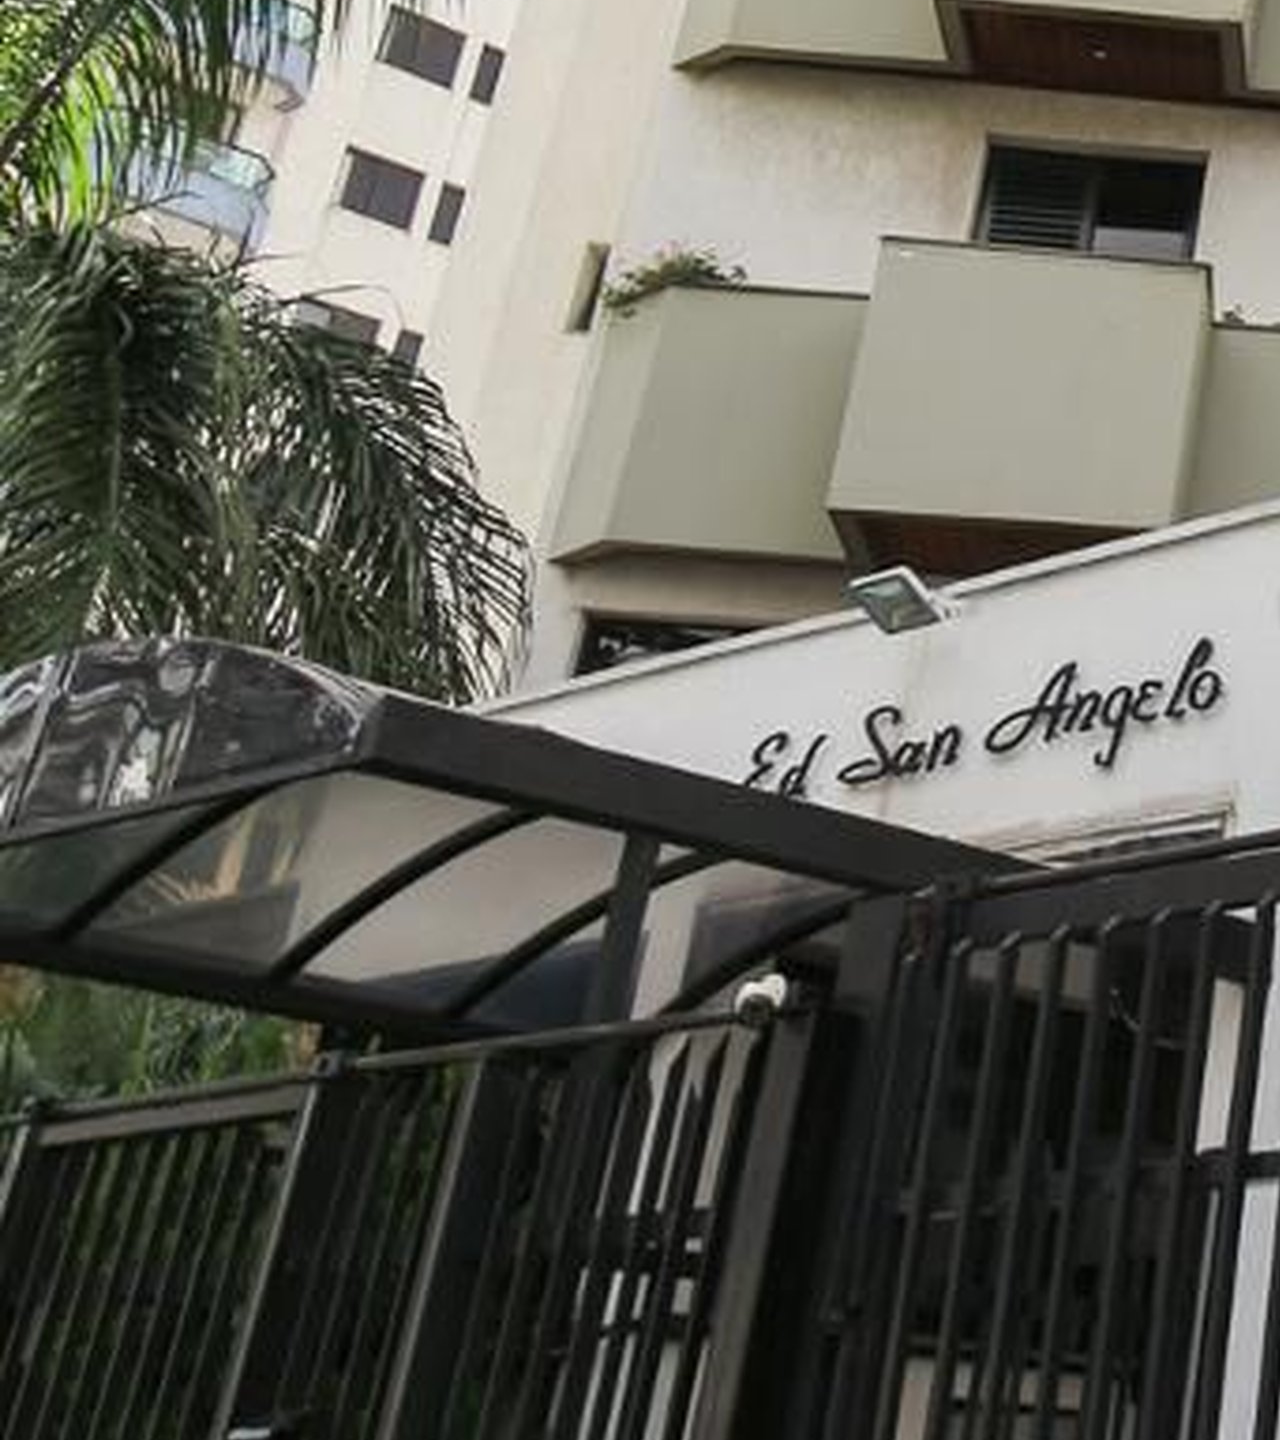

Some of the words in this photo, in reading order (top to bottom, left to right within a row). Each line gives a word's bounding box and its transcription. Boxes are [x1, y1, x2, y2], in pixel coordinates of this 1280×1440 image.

[744, 731, 828, 797] Ed
[837, 705, 962, 788] San
[985, 638, 1226, 769] Angelo
